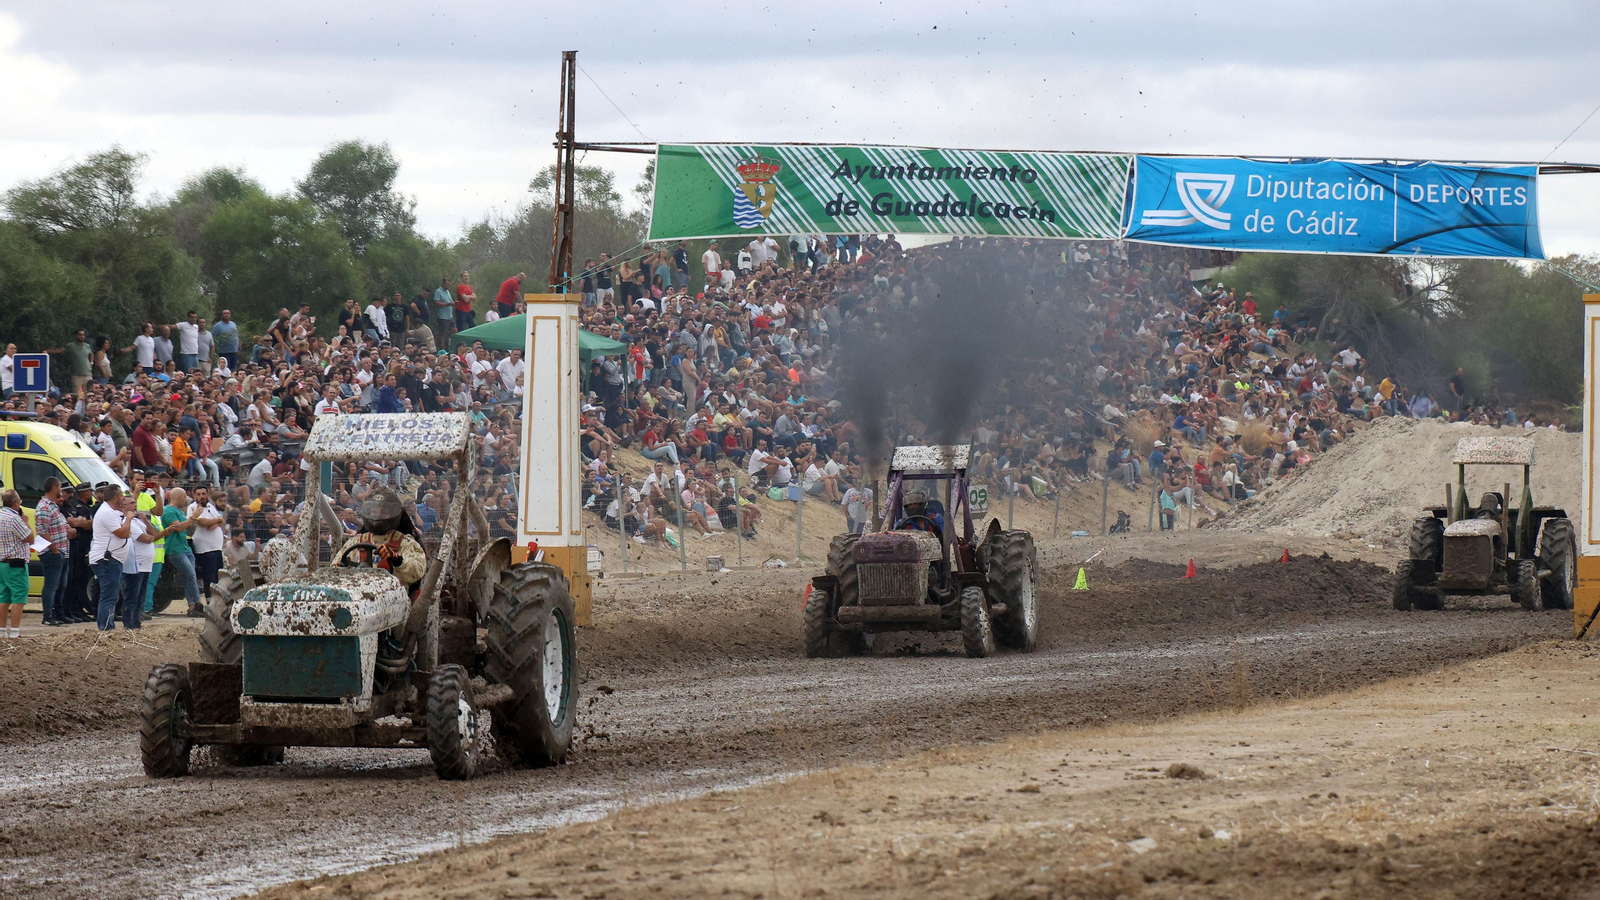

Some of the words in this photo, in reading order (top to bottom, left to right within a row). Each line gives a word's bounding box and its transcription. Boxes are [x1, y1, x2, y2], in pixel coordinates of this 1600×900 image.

[830, 157, 1038, 185] Ayuntamiento
[1246, 174, 1385, 203] Diputación
[1410, 184, 1528, 206] DEPORTES
[825, 192, 860, 217] de
[870, 192, 1056, 223] Guadalcacín
[1243, 208, 1276, 234] de
[1286, 209, 1359, 237] Cádiz
[969, 488, 987, 506] 09
